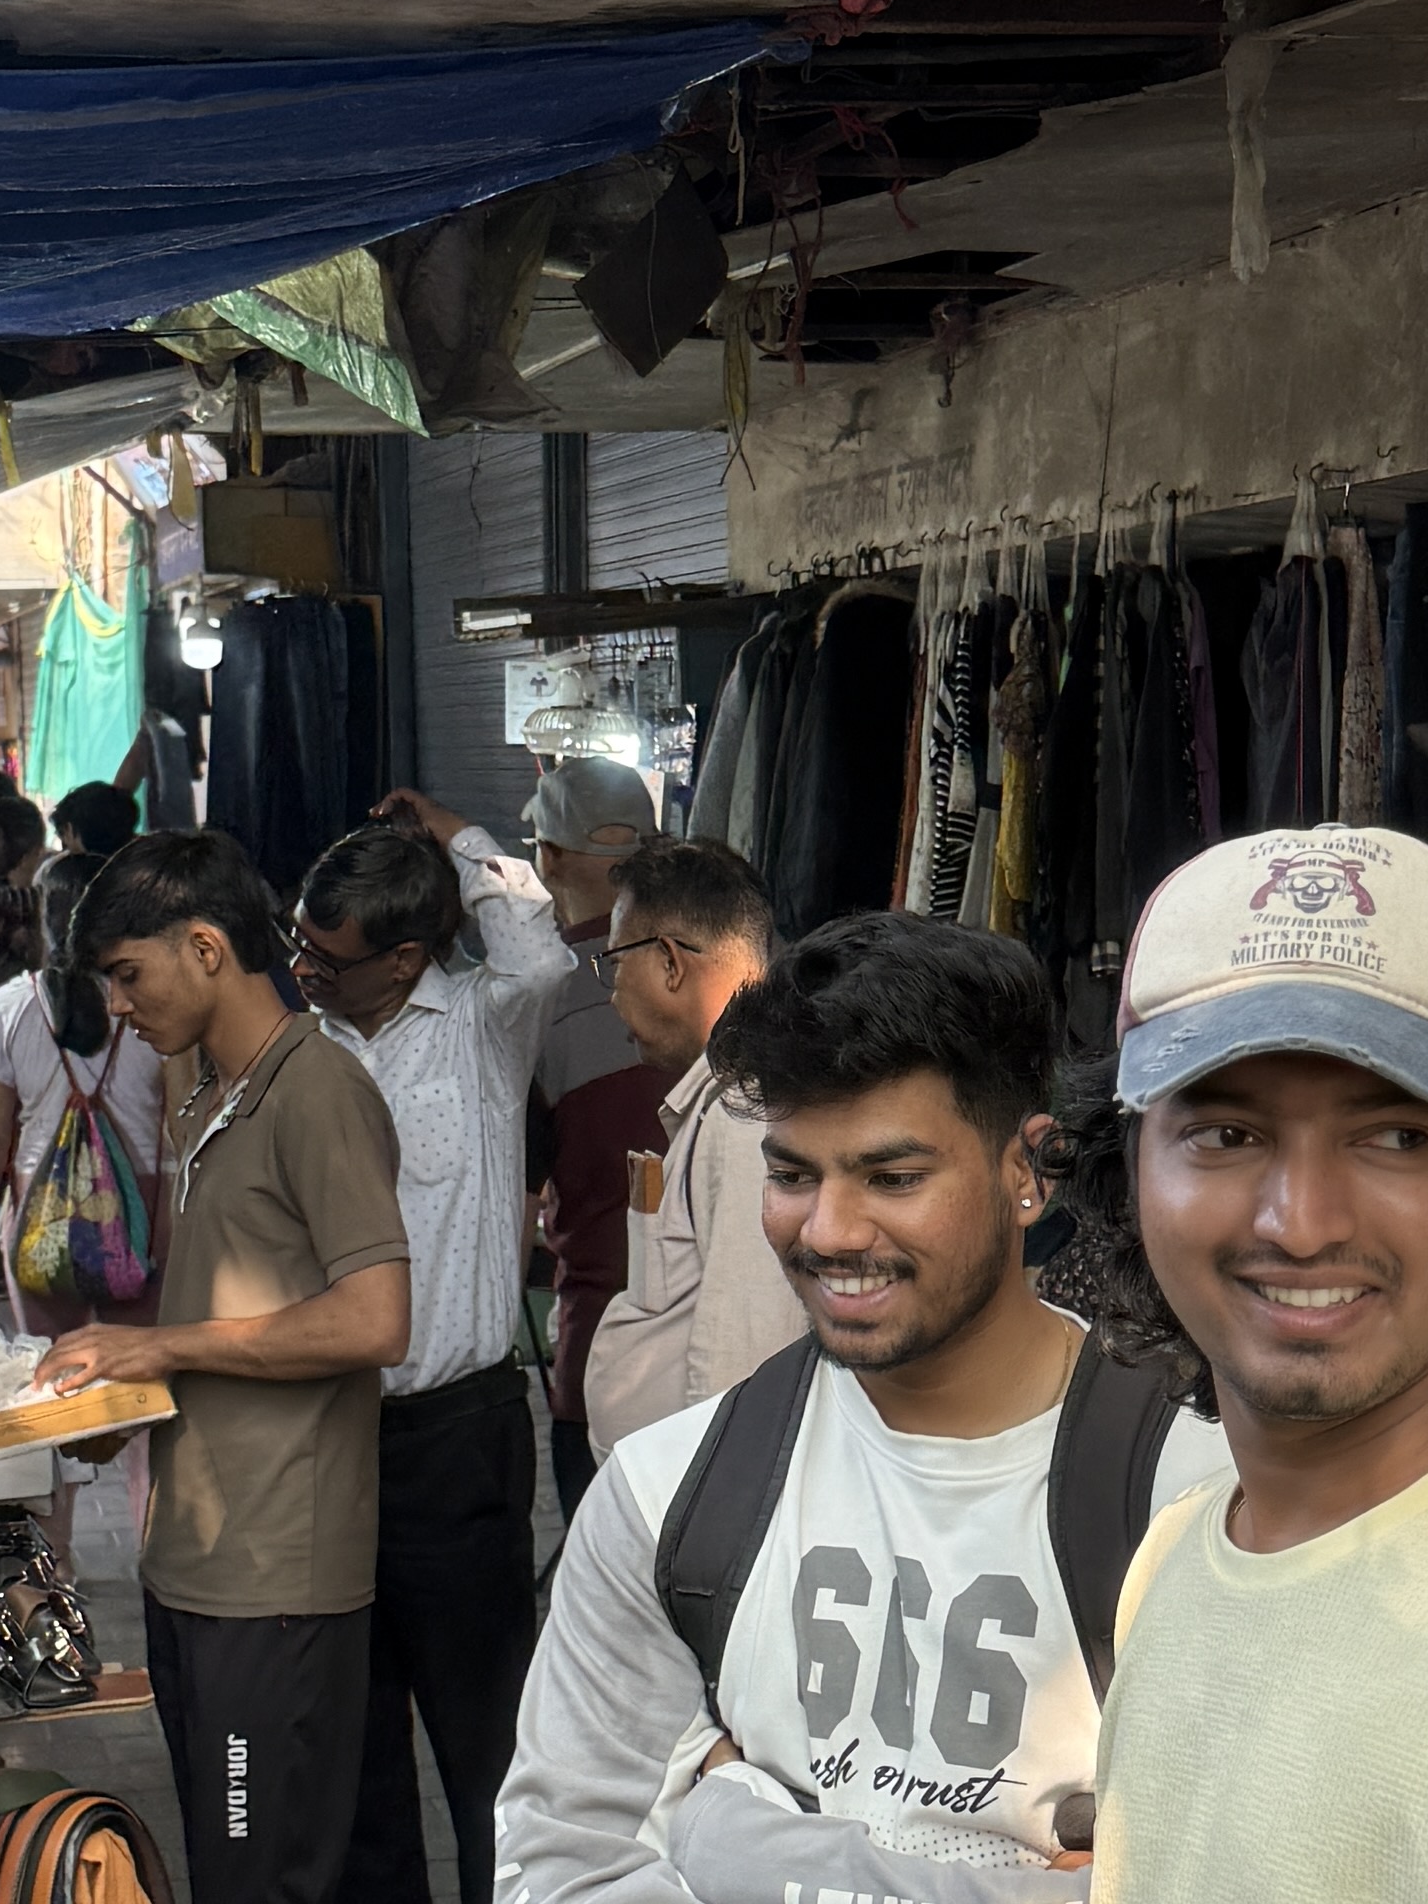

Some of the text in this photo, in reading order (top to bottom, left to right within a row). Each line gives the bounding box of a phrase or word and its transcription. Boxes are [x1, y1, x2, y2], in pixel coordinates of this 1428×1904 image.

[1254, 930, 1362, 947] IT'S FOR US
[1231, 942, 1388, 974] MILITARY POLICE
[226, 1733, 248, 1838] JORDAN
